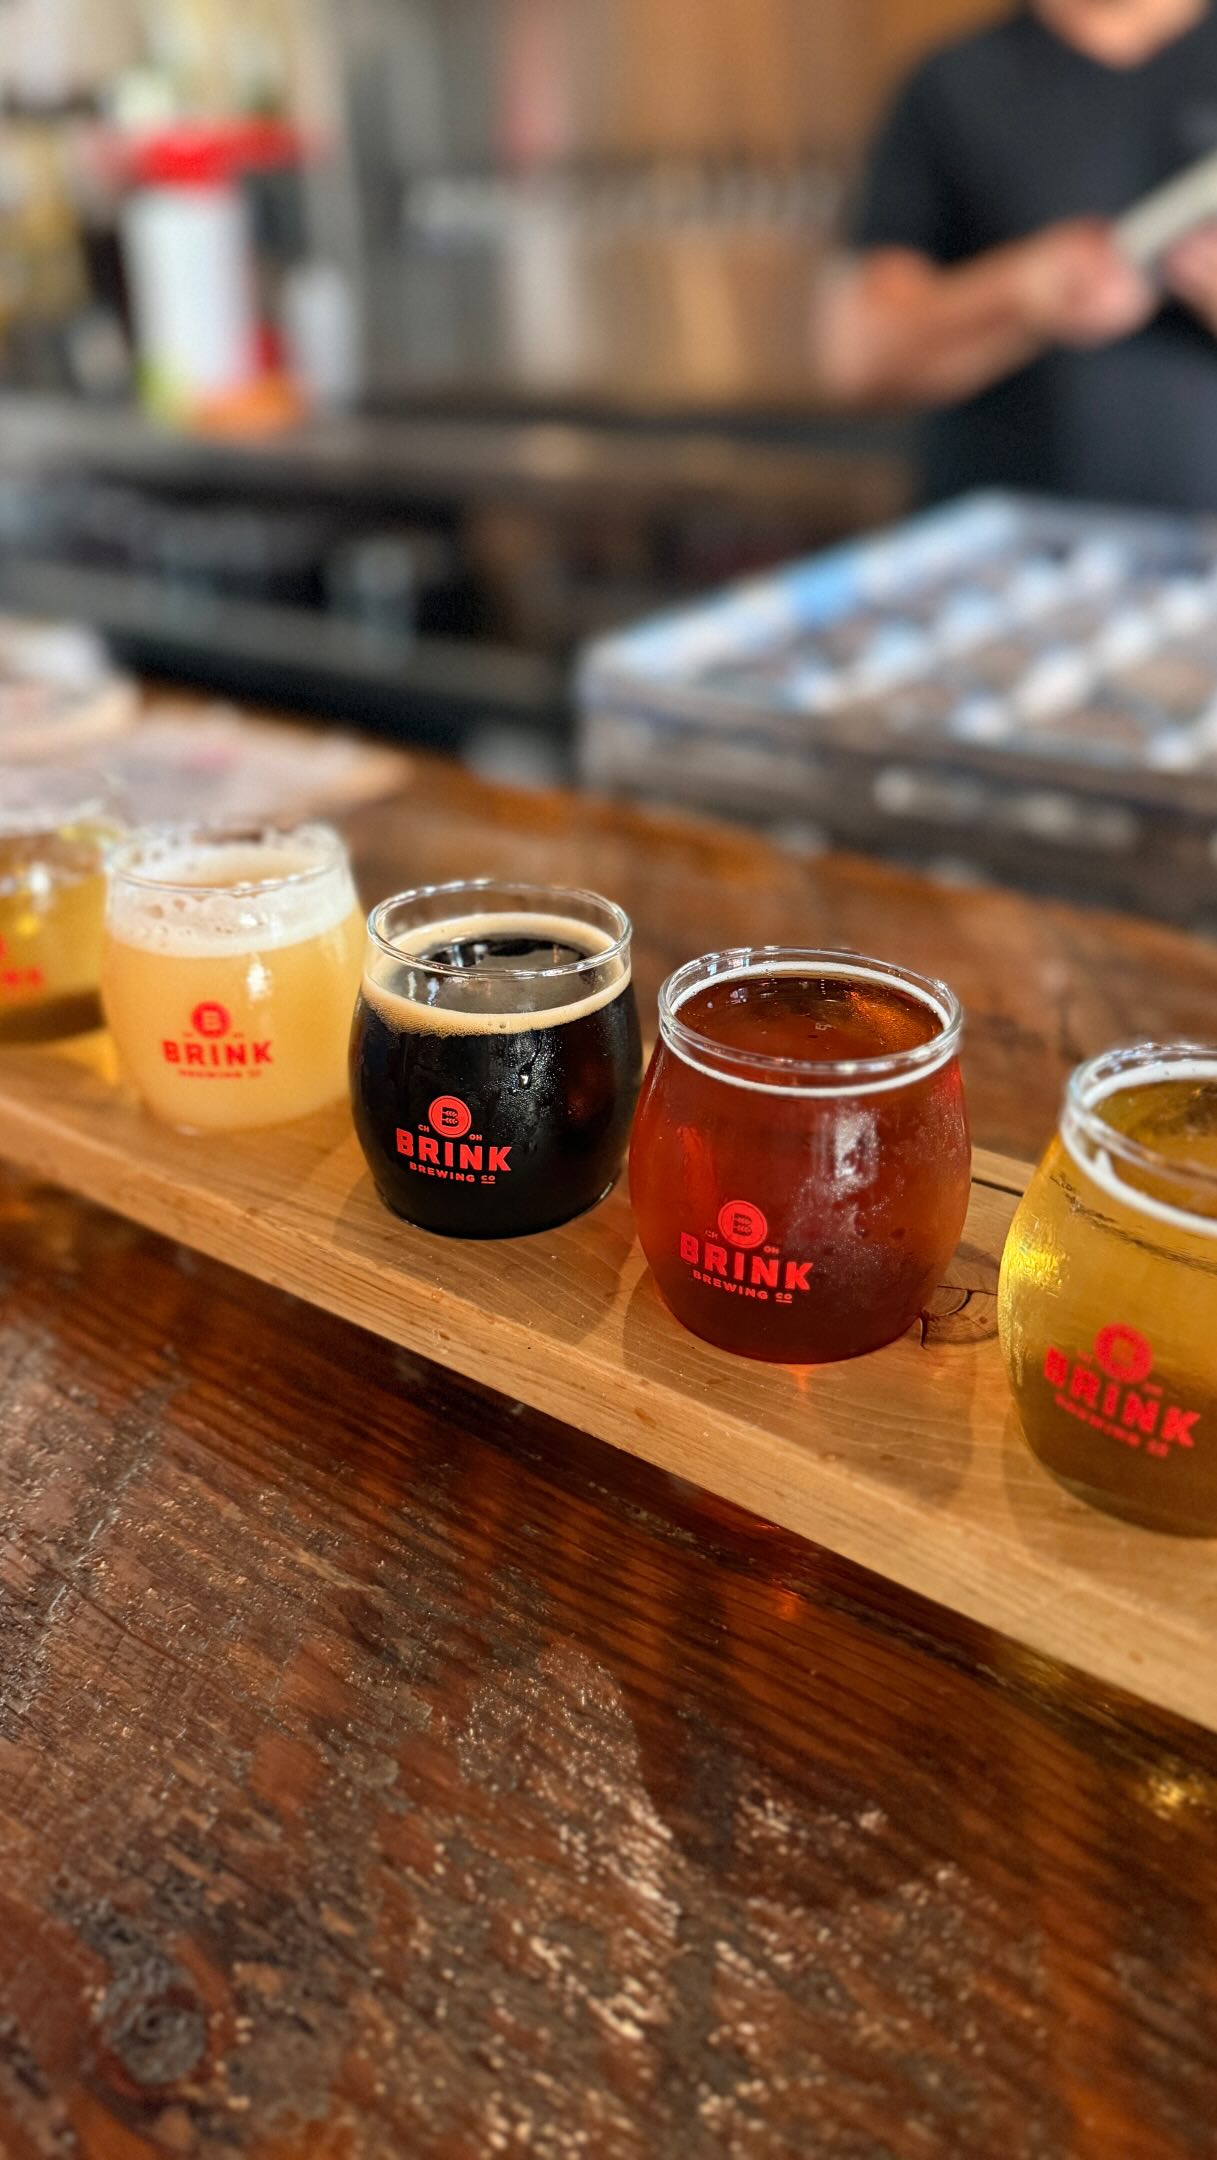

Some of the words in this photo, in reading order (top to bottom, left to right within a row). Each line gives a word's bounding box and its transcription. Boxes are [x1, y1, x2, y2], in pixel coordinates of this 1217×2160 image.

[162, 1040, 273, 1067] BRINK
[396, 1127, 512, 1172] BRINK
[409, 1161, 475, 1183] BREWING
[481, 1175, 496, 1185] CO
[680, 1231, 814, 1291] BRINK
[693, 1269, 769, 1300] BREWING
[775, 1292, 793, 1304] CO
[1044, 1344, 1201, 1448] BRINK
